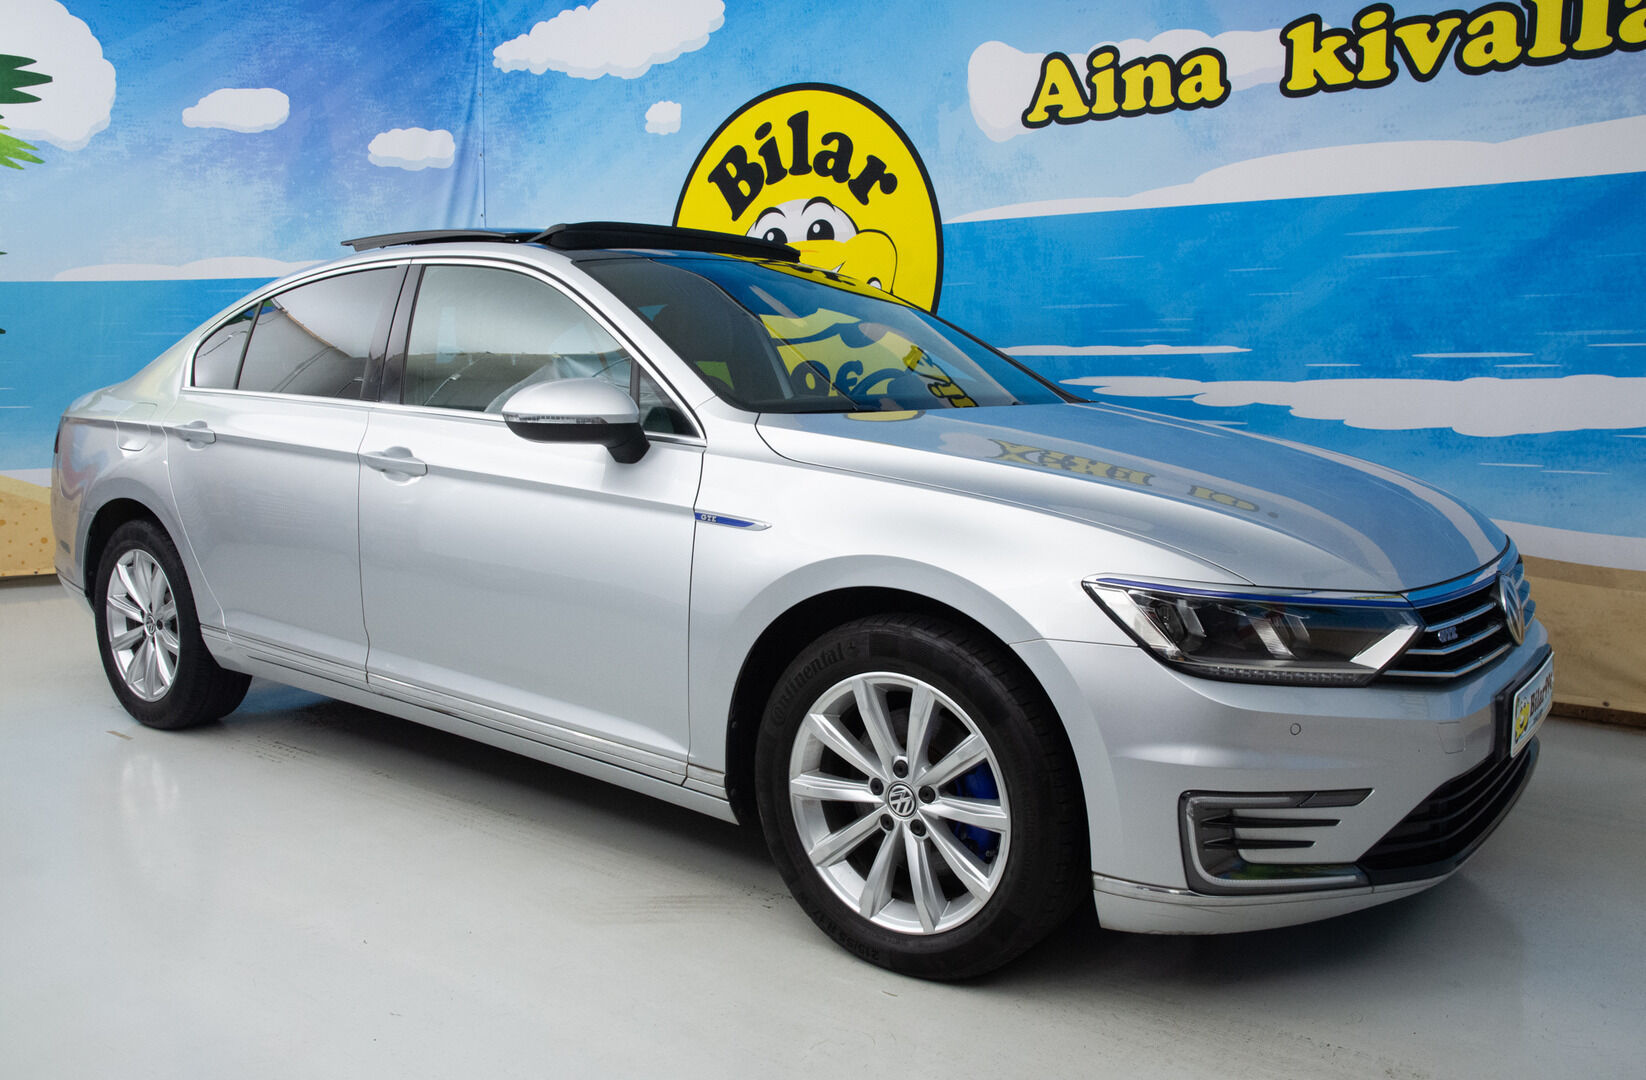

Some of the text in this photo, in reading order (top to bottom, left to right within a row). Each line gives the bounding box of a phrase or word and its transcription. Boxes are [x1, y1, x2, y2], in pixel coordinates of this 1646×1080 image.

[1022, 45, 1231, 129] Aina
[708, 110, 898, 221] Bilar
[701, 514, 717, 523] GTE
[771, 642, 845, 726] Continental
